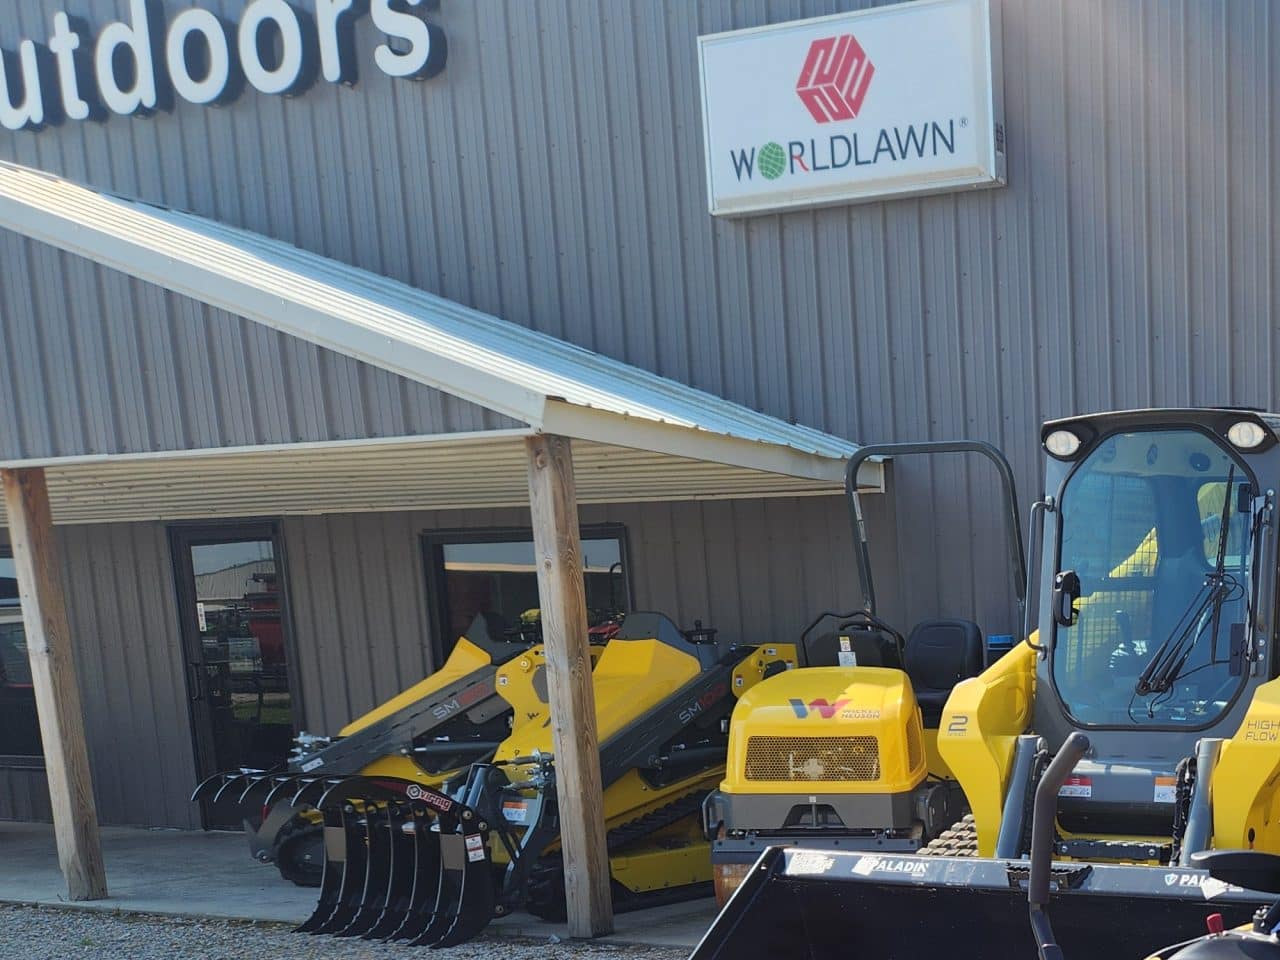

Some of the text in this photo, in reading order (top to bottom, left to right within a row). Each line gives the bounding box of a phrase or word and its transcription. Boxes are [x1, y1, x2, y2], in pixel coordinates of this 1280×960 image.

[948, 715, 968, 731] 2
[1247, 720, 1280, 730] HIGH
[1246, 731, 1278, 741] FLOW
